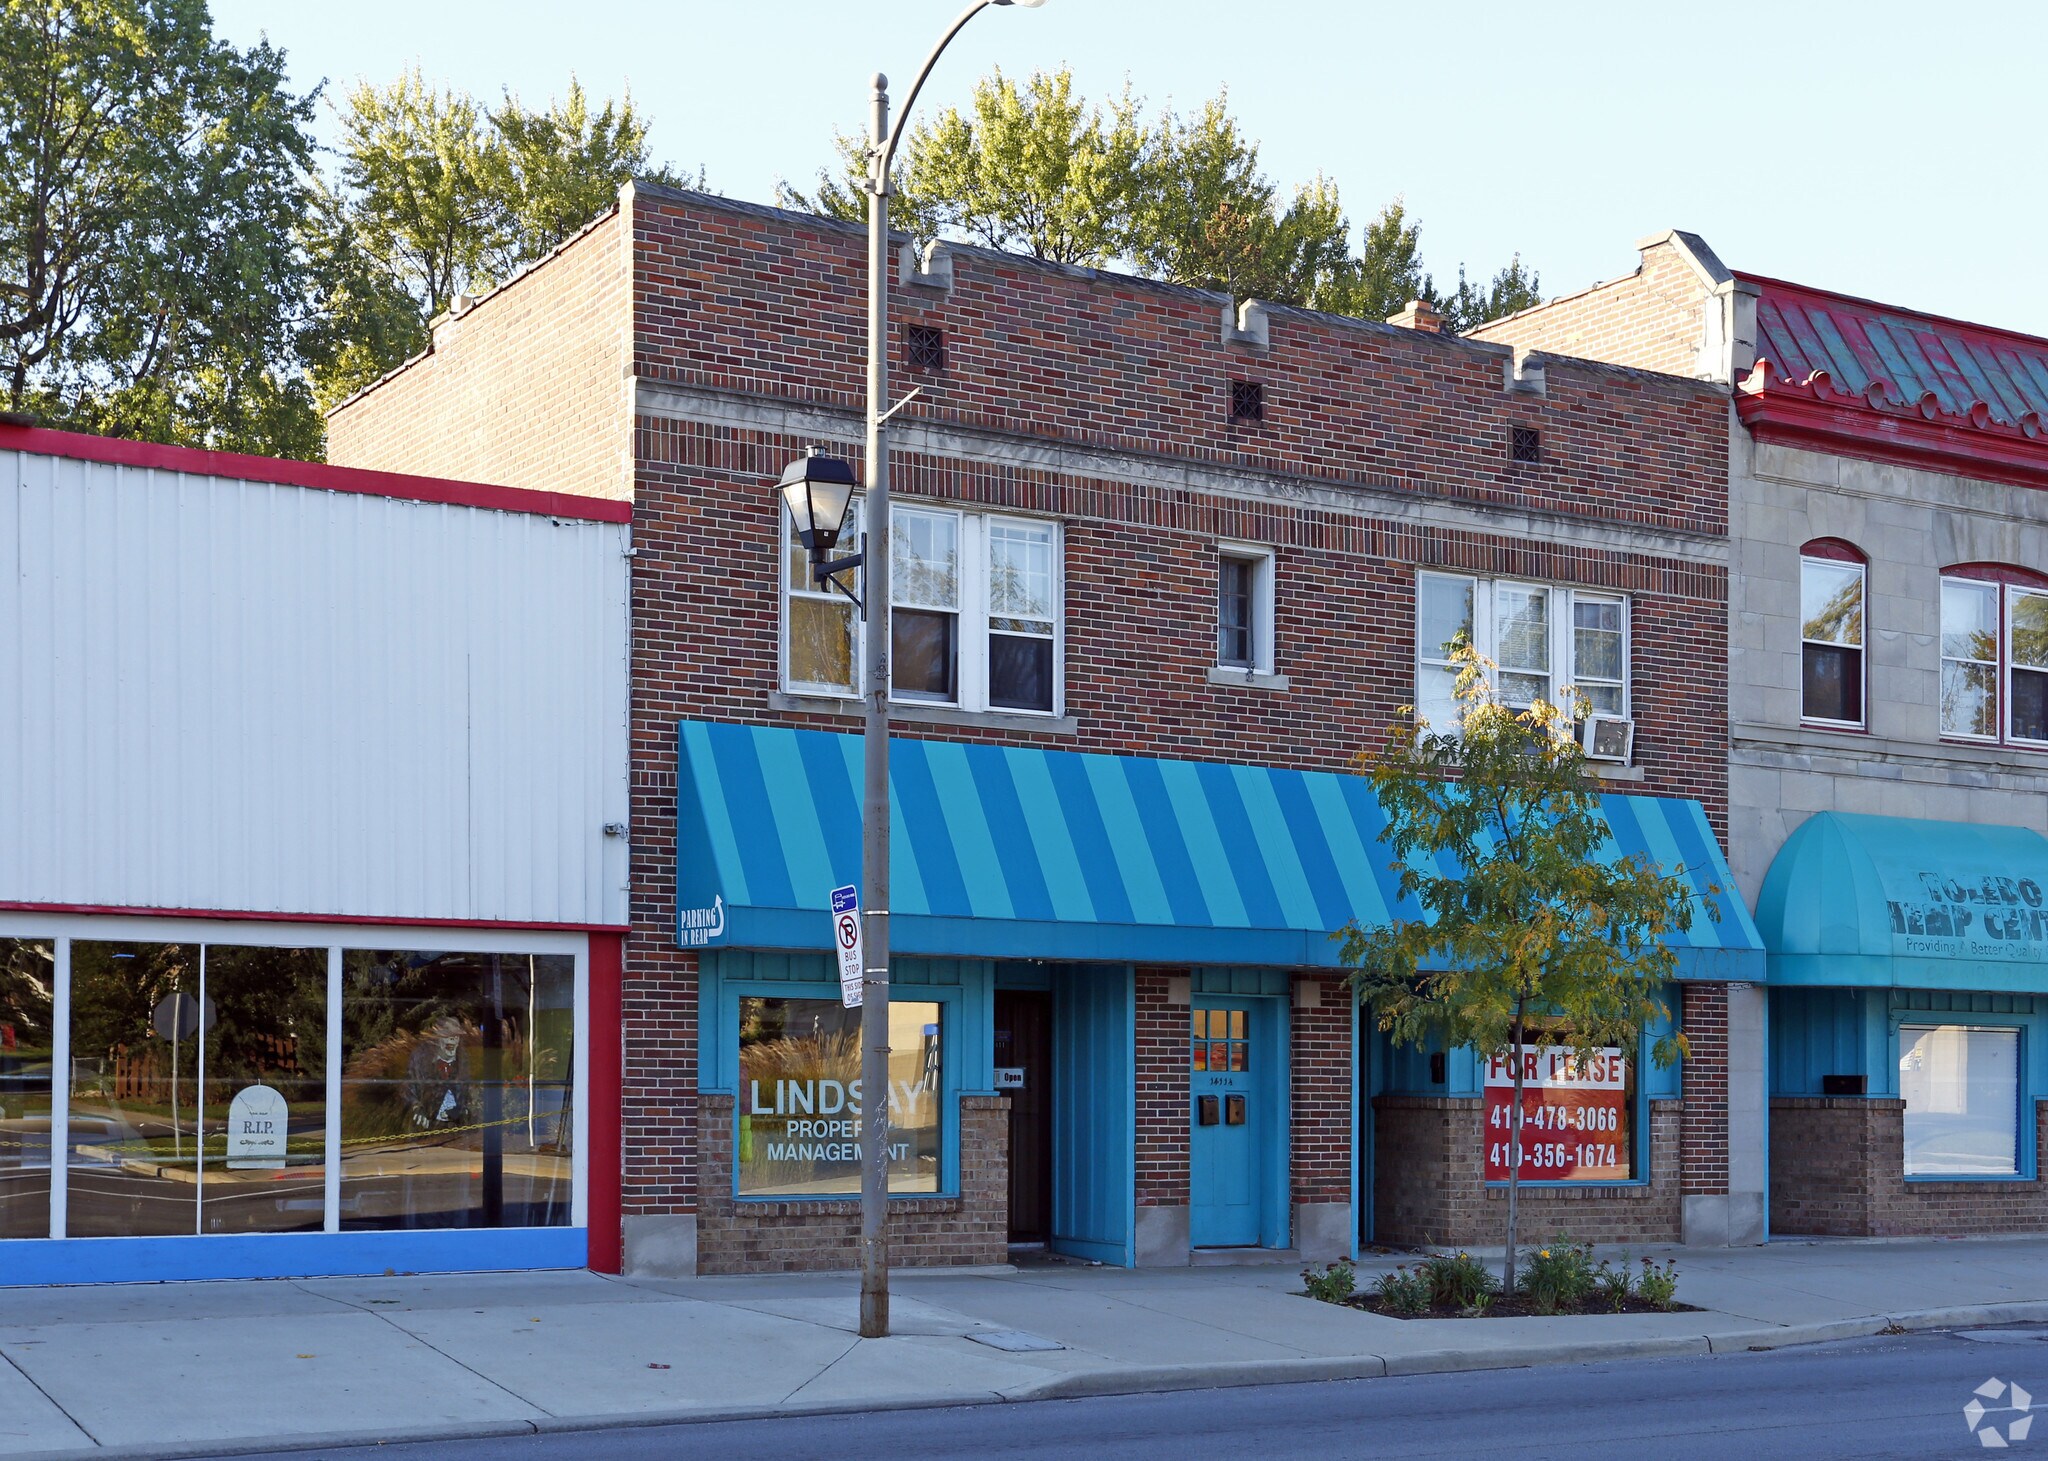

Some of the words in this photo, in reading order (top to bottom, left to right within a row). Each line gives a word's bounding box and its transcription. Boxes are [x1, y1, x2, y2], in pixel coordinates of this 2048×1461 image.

[681, 907, 716, 929] PARKING
[681, 929, 689, 946] IN
[690, 928, 708, 946] REAR
[844, 950, 857, 962] BUS
[1906, 937, 1957, 957] Providing
[1970, 940, 2003, 956] Better
[844, 963, 860, 976] STOP
[1490, 1052, 1538, 1080] FOR
[1004, 1072, 1022, 1083] Open
[243, 1120, 274, 1134] R.I.P.
[767, 1143, 909, 1161] MANAGENT
